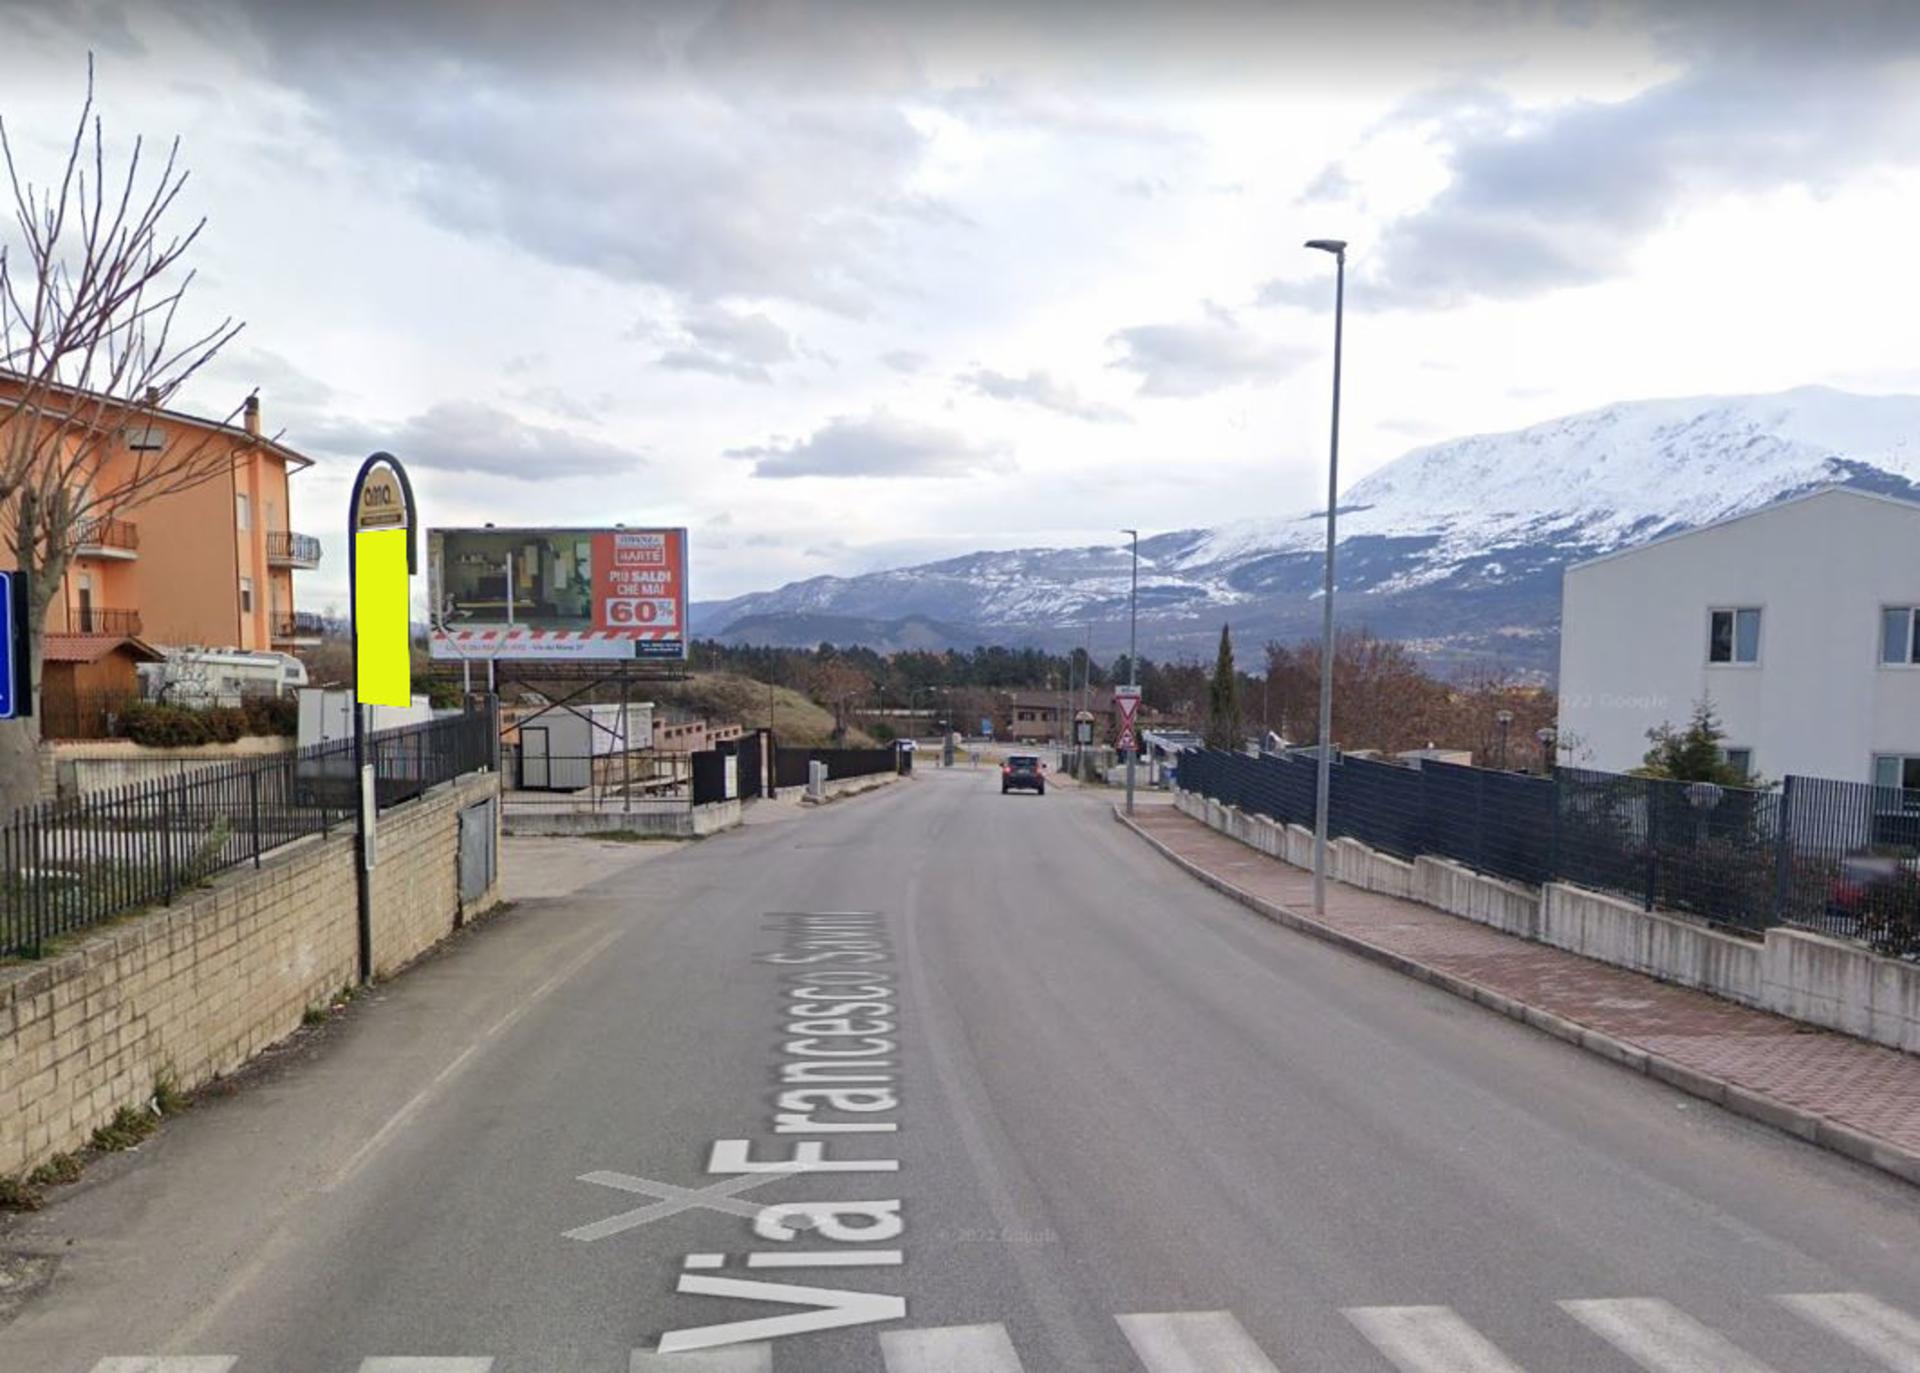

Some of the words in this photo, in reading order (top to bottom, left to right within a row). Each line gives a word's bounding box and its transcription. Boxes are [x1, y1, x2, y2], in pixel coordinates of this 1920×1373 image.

[632, 570, 671, 583] SALDI
[617, 584, 640, 597] CHE
[641, 584, 664, 597] MAI
[610, 600, 673, 623] 60%
